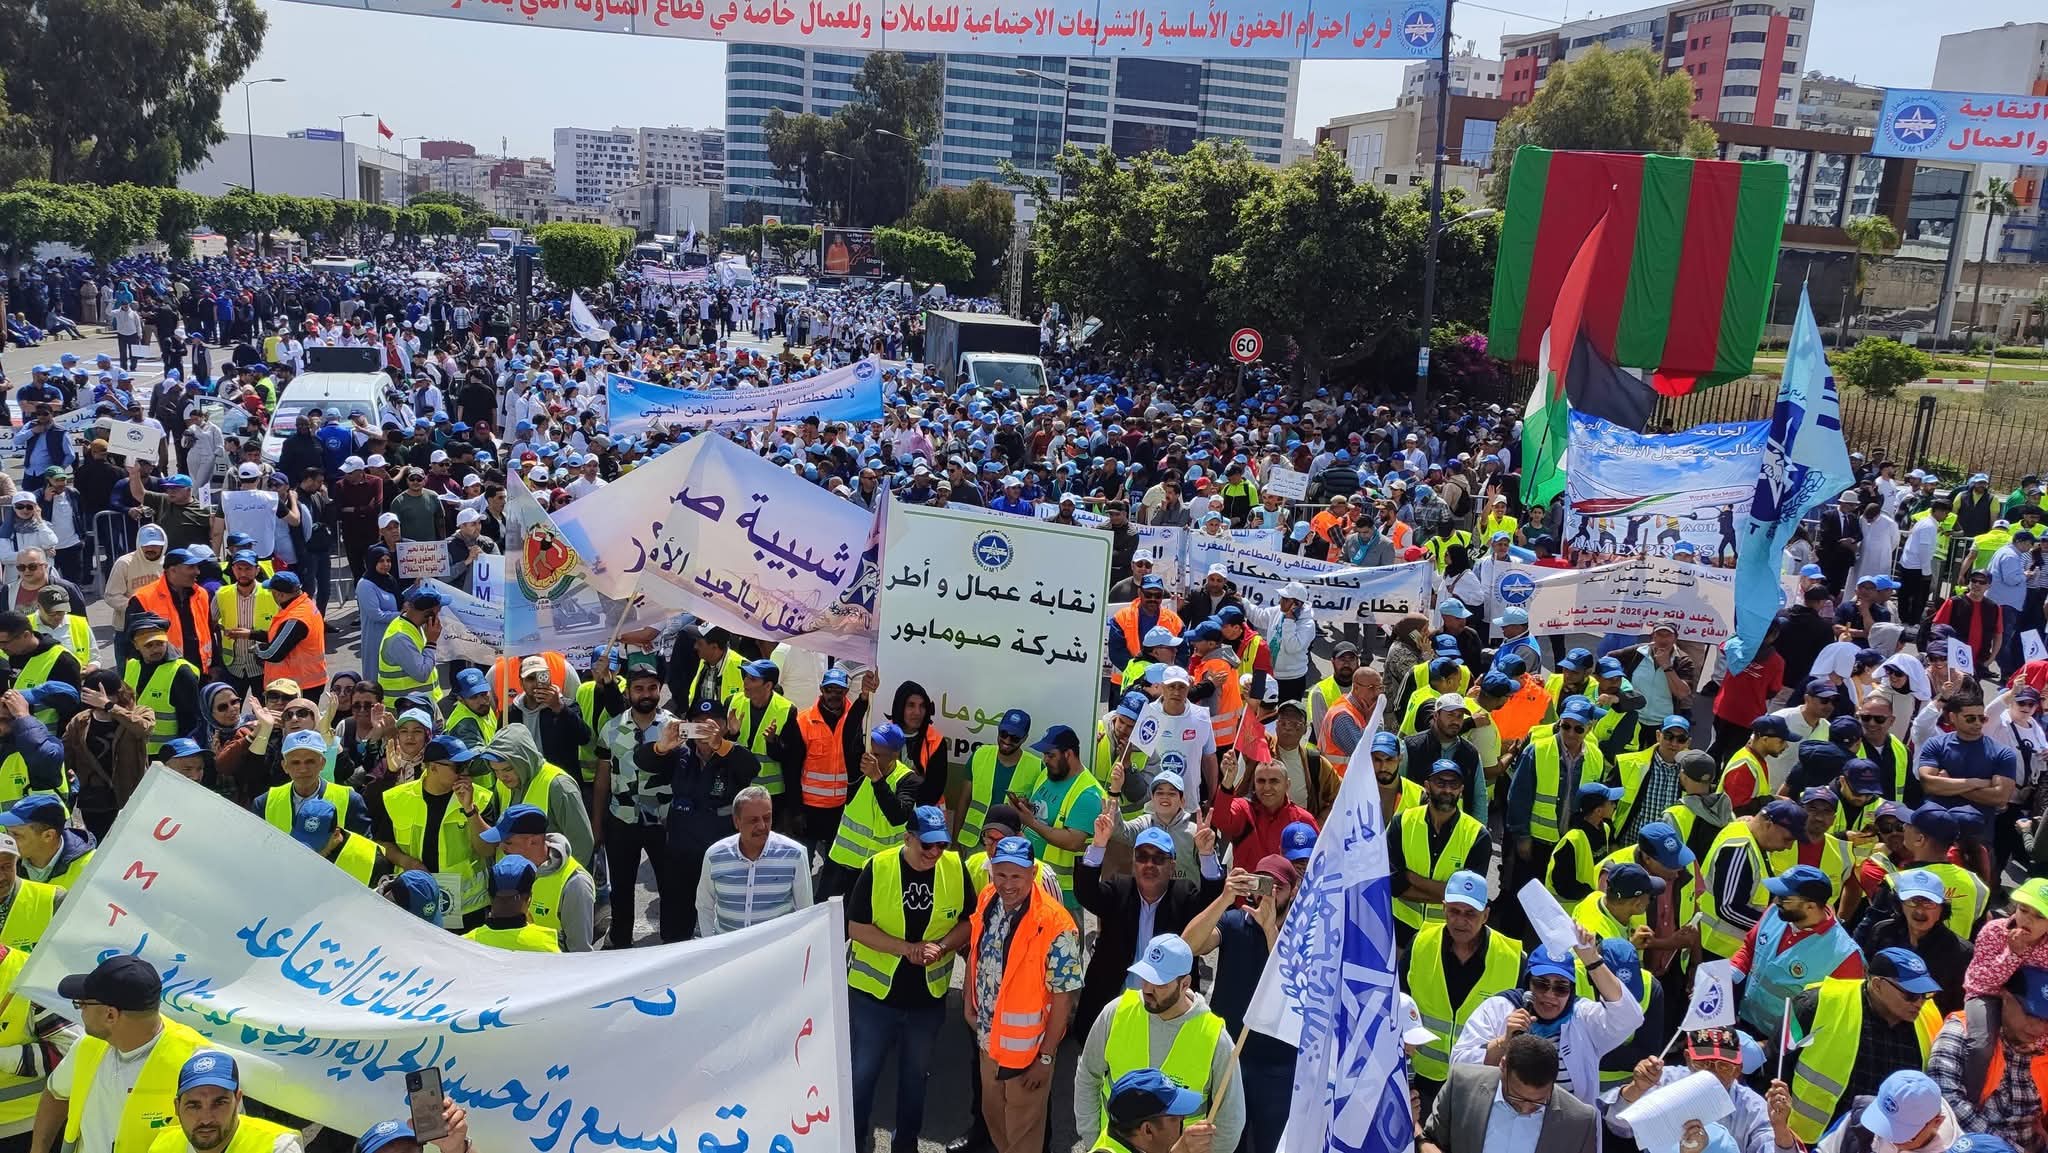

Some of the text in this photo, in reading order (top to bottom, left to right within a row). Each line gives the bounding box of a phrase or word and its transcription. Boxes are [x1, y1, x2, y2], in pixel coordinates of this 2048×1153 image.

[709, 1, 738, 36] في
[743, 0, 795, 25] خاصة
[799, 1, 872, 39] وللعمال
[880, 4, 960, 34] للعاملات
[963, 8, 1055, 44] الاجتماعية
[1158, 5, 1227, 47] الأساسية
[1057, 8, 1153, 47] والتشريعات
[1229, 11, 1293, 48] الحقوق
[1295, 10, 1350, 48] احترام
[1352, 9, 1392, 48] فرض
[1948, 126, 2048, 156] والعمال
[1237, 338, 1256, 352] 60
[847, 387, 855, 400] لا
[1692, 425, 1747, 438] الجامع
[735, 493, 850, 587] شبيبة
[1197, 541, 1236, 554] بالمغرب
[1616, 543, 1715, 557] EXPRSS
[1237, 549, 1282, 567] والمطاعم
[1658, 566, 1695, 578] المغربي
[1699, 572, 1733, 582] الاتحاد
[694, 568, 760, 620] بالعيد
[885, 558, 1096, 615] نقابة عمال و أطر
[1356, 598, 1409, 618] قطاع
[1592, 605, 1616, 614] تحت
[1663, 609, 1685, 619] فاتح
[1688, 613, 1714, 625] يخلد
[890, 618, 1001, 650] صومابور
[1683, 627, 1697, 635] عن
[1701, 628, 1728, 638] الدفاع
[1010, 628, 1088, 665] شركة
[153, 817, 182, 841] U
[122, 860, 159, 890] M
[108, 903, 127, 927] T
[236, 916, 388, 1004] التقاعد
